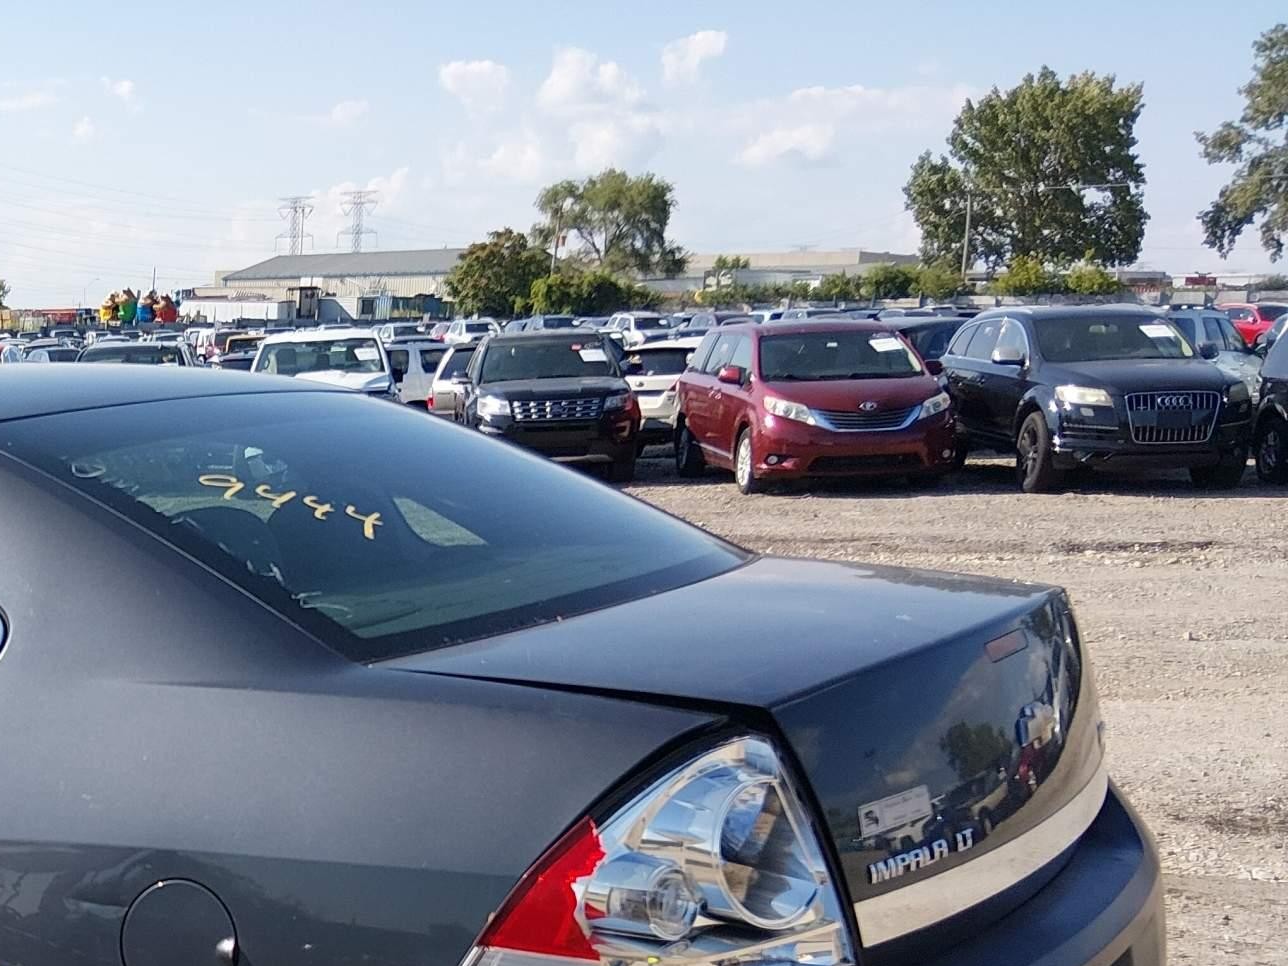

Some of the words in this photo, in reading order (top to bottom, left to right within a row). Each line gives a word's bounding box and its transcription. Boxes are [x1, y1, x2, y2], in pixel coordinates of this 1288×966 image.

[198, 474, 384, 540] 9444
[868, 839, 949, 884] IMPALA
[956, 828, 974, 852] LT
